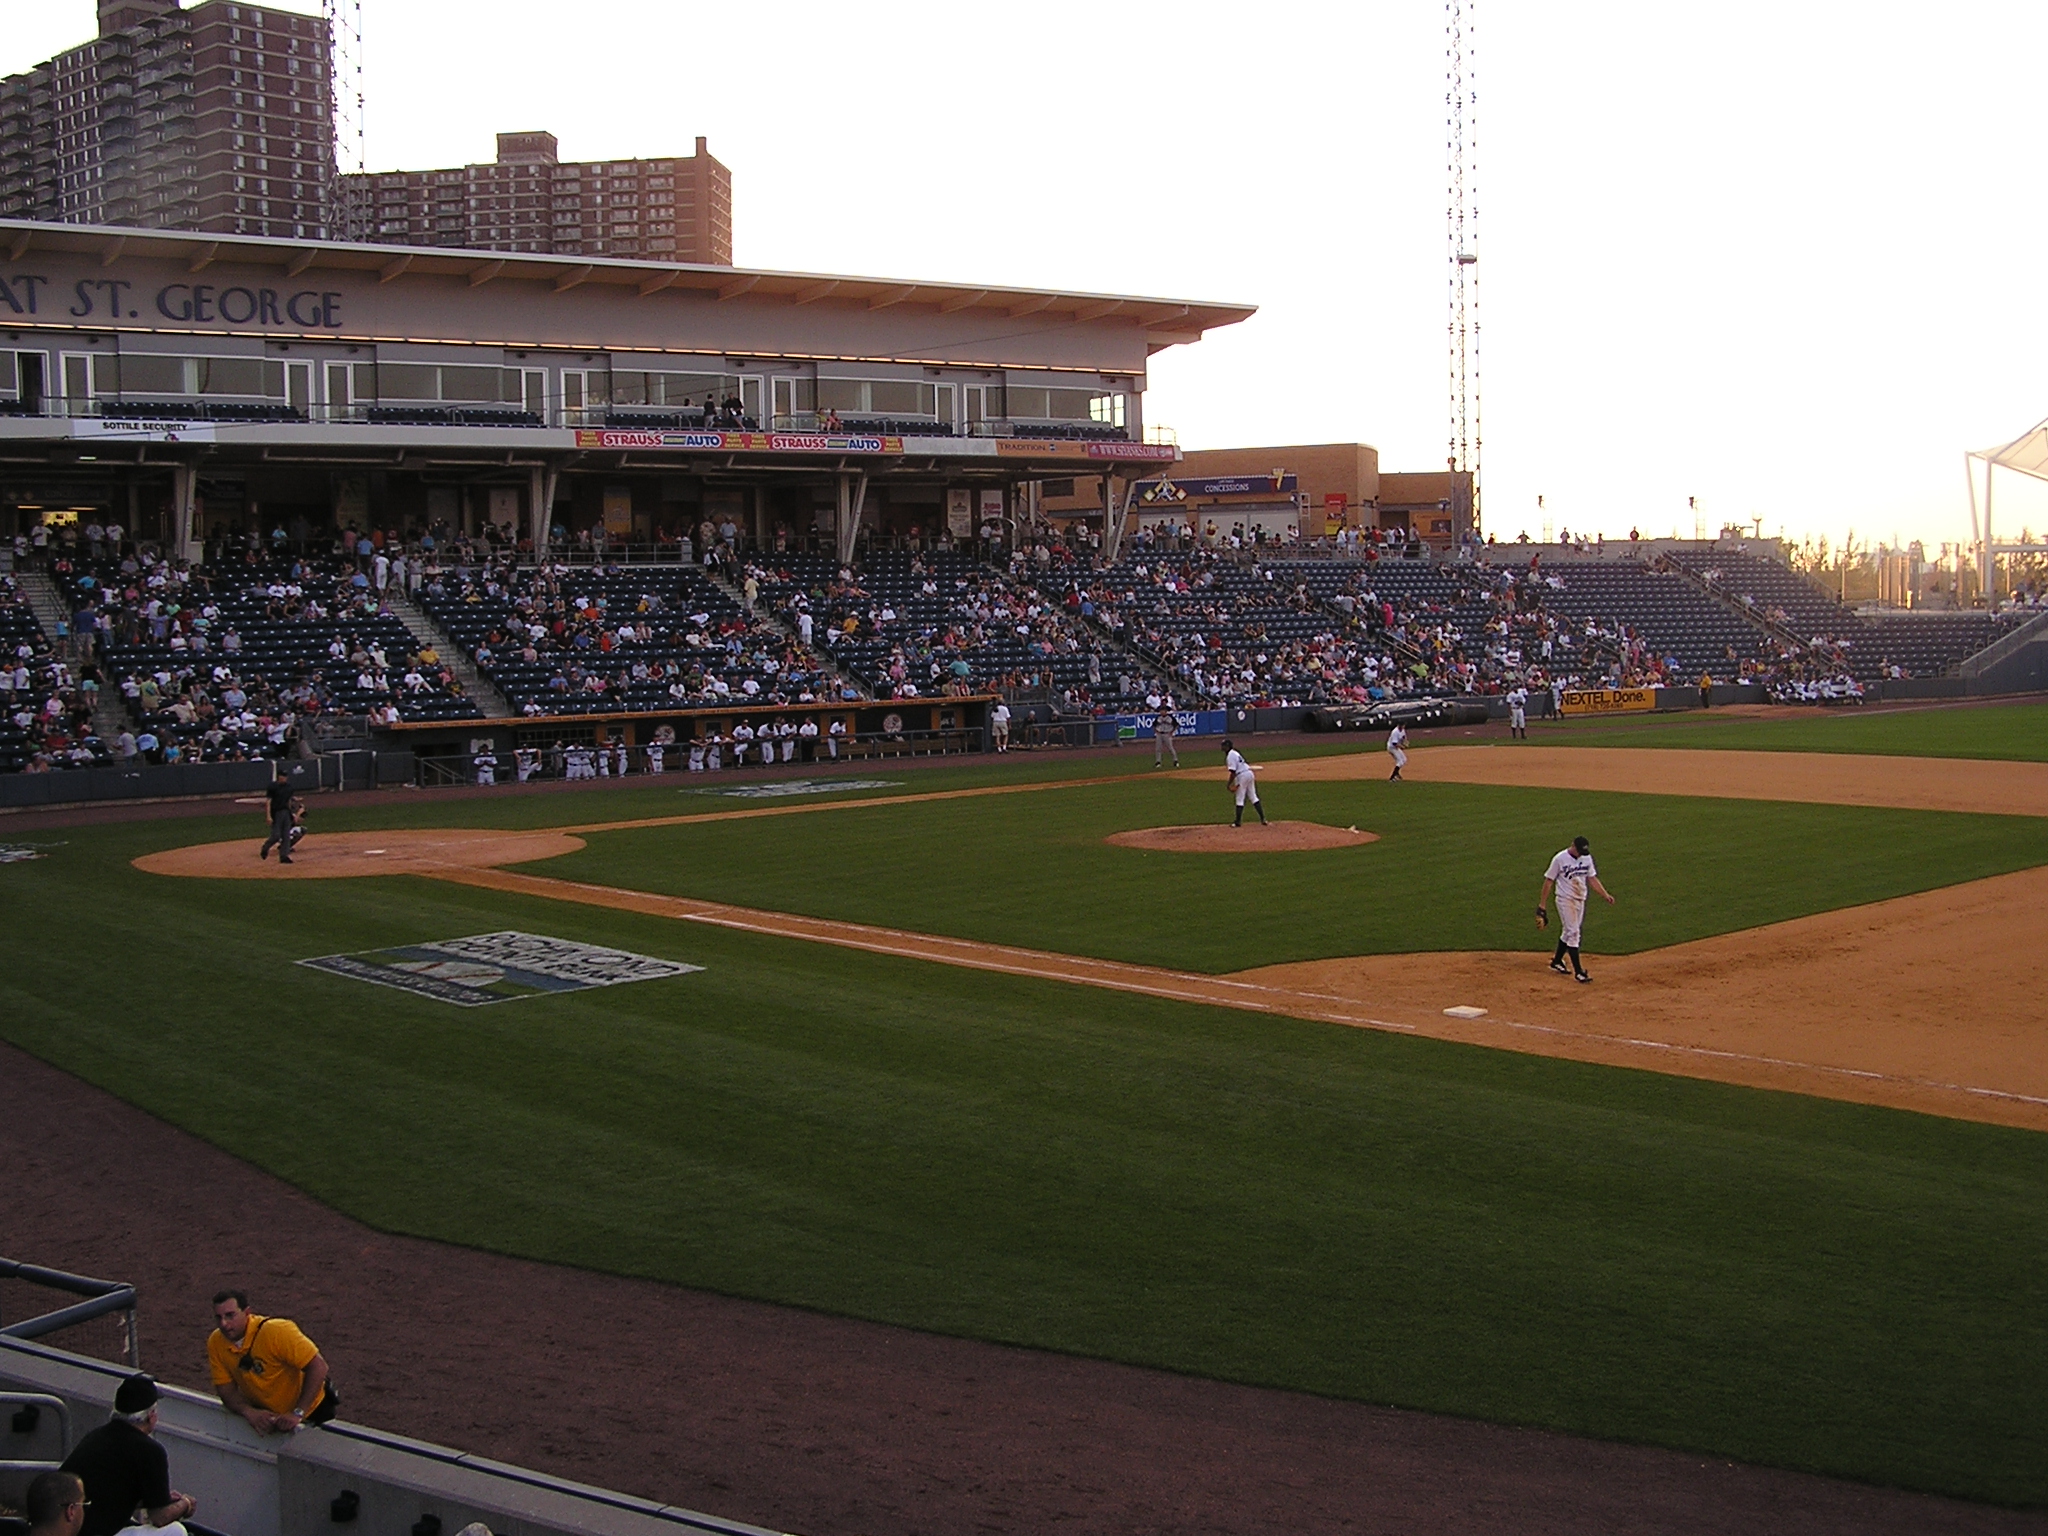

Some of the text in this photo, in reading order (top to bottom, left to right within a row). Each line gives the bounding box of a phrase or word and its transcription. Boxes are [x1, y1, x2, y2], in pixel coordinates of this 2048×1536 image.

[69, 279, 138, 318] ST.
[156, 284, 343, 328] GEORGE
[103, 422, 188, 431] SOTTILE SECURITY
[604, 433, 662, 446] STRAUSS
[686, 435, 721, 447] AUTO
[773, 437, 827, 449] STRAUSS
[848, 438, 881, 450] AUTO
[998, 442, 1046, 451] TRADITION
[1204, 483, 1250, 493] CONCESSIONS
[1613, 690, 1646, 703] Done.
[1180, 727, 1197, 735] Bank
